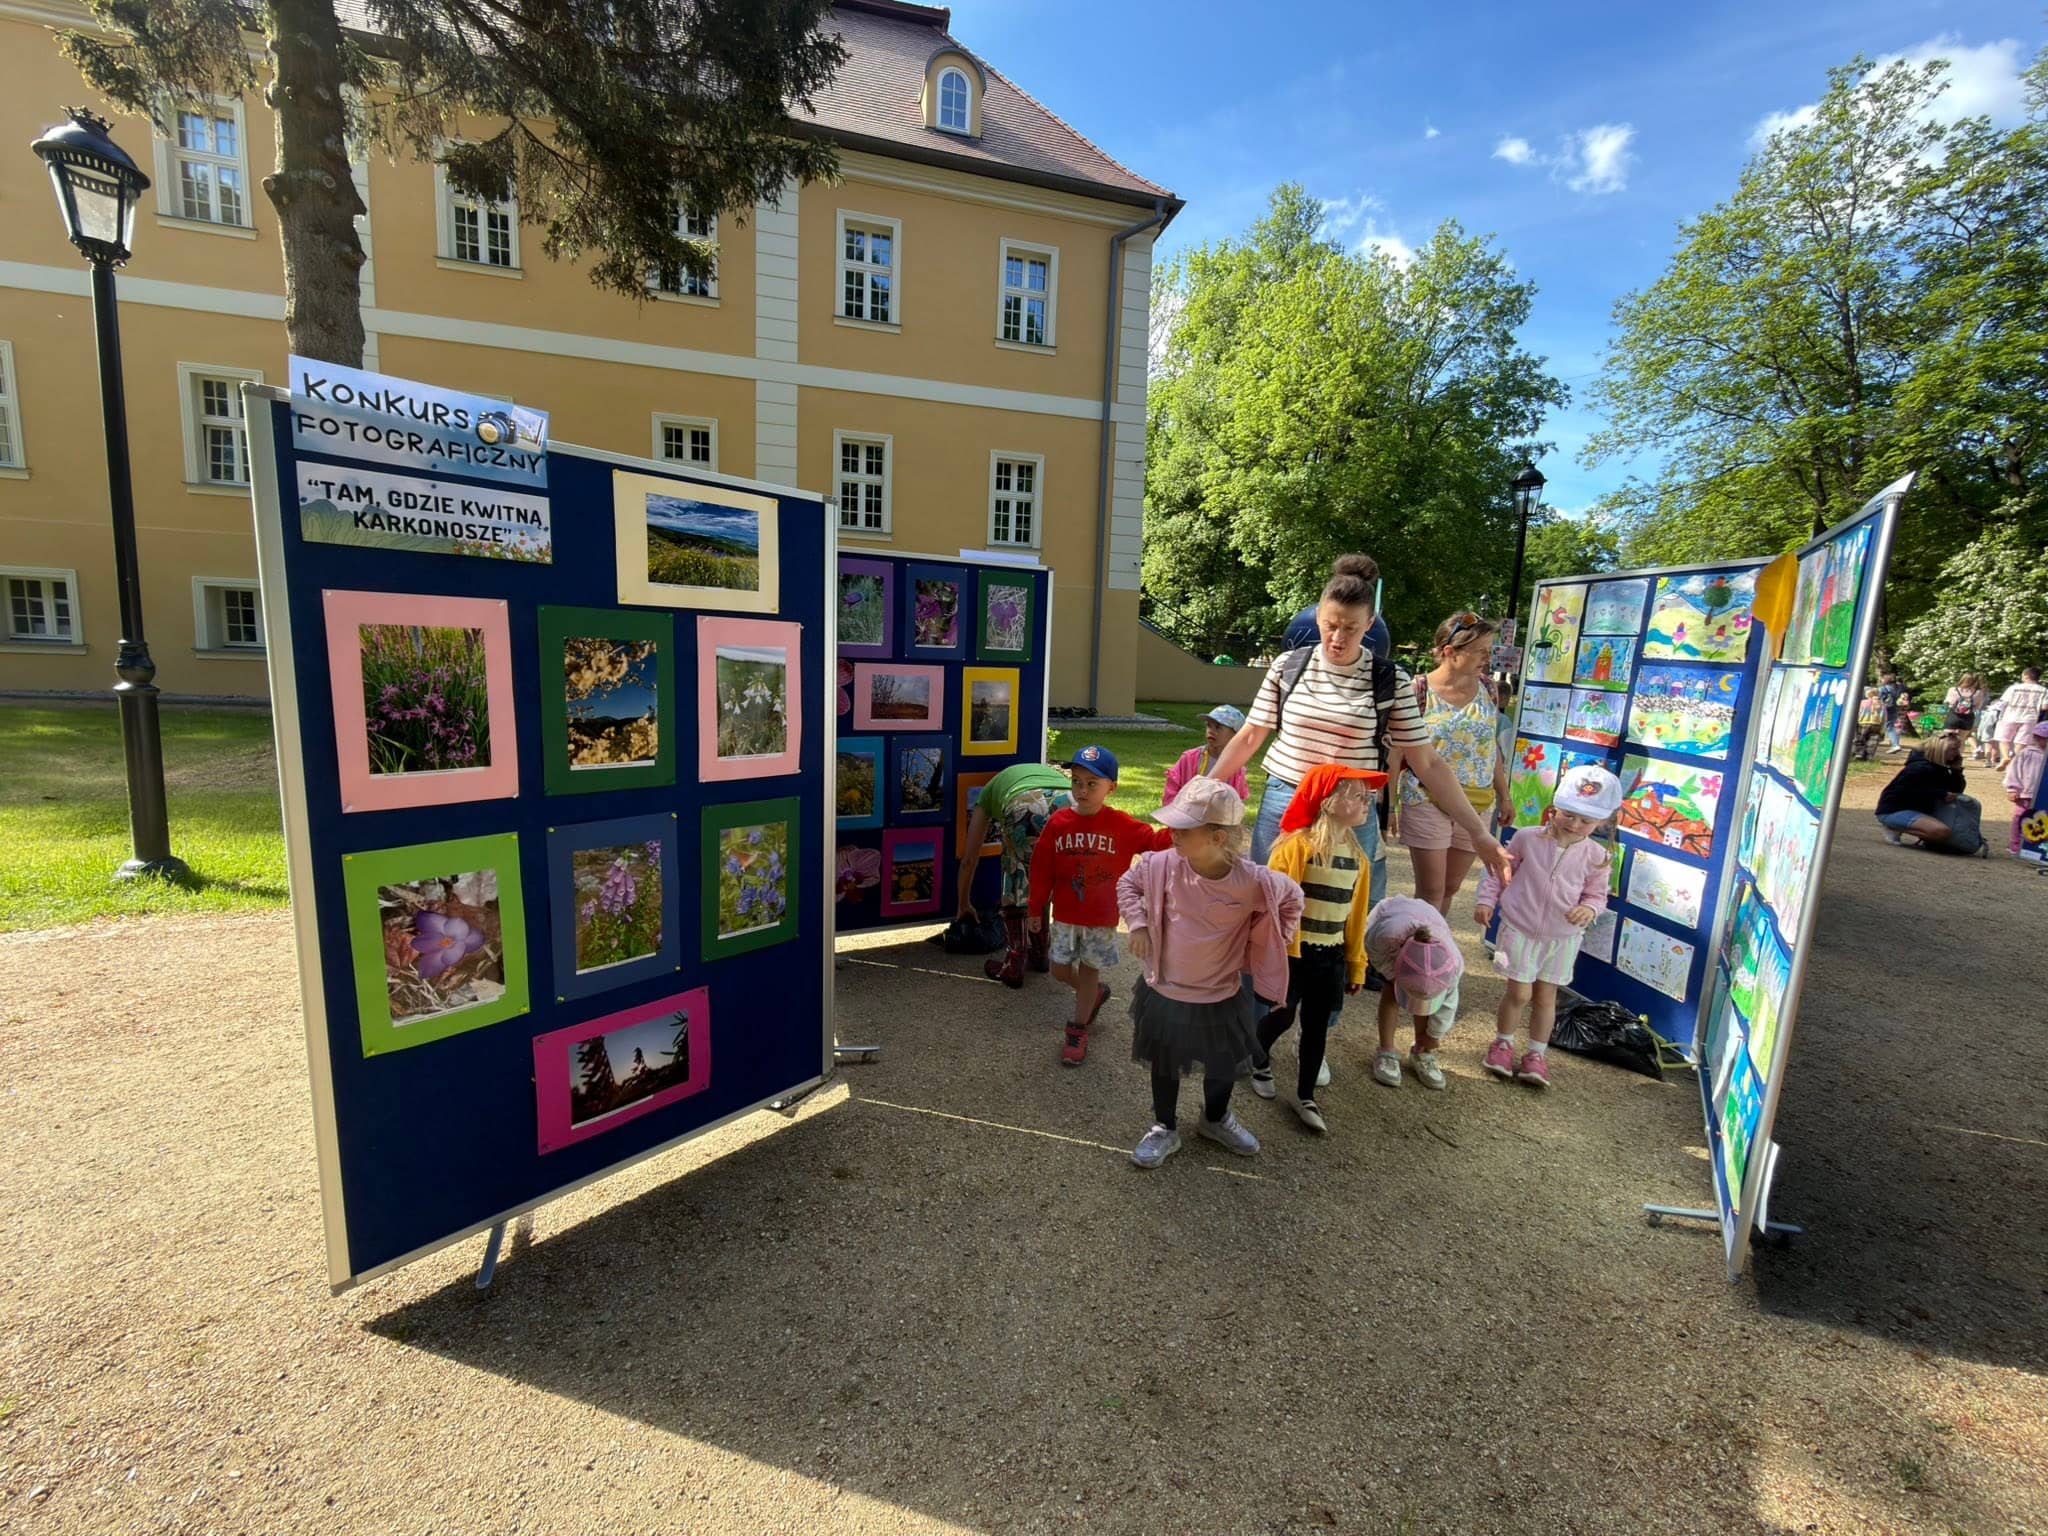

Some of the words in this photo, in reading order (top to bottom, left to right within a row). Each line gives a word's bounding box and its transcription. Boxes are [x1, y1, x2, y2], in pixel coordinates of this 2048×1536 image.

[303, 372, 469, 429] KONKURS
[297, 413, 542, 474] FOTOGRAFICZNY
[388, 490, 454, 514] GDZIE
[461, 500, 543, 530] KWITNĄ
[1055, 832, 1116, 854] MARVEL
